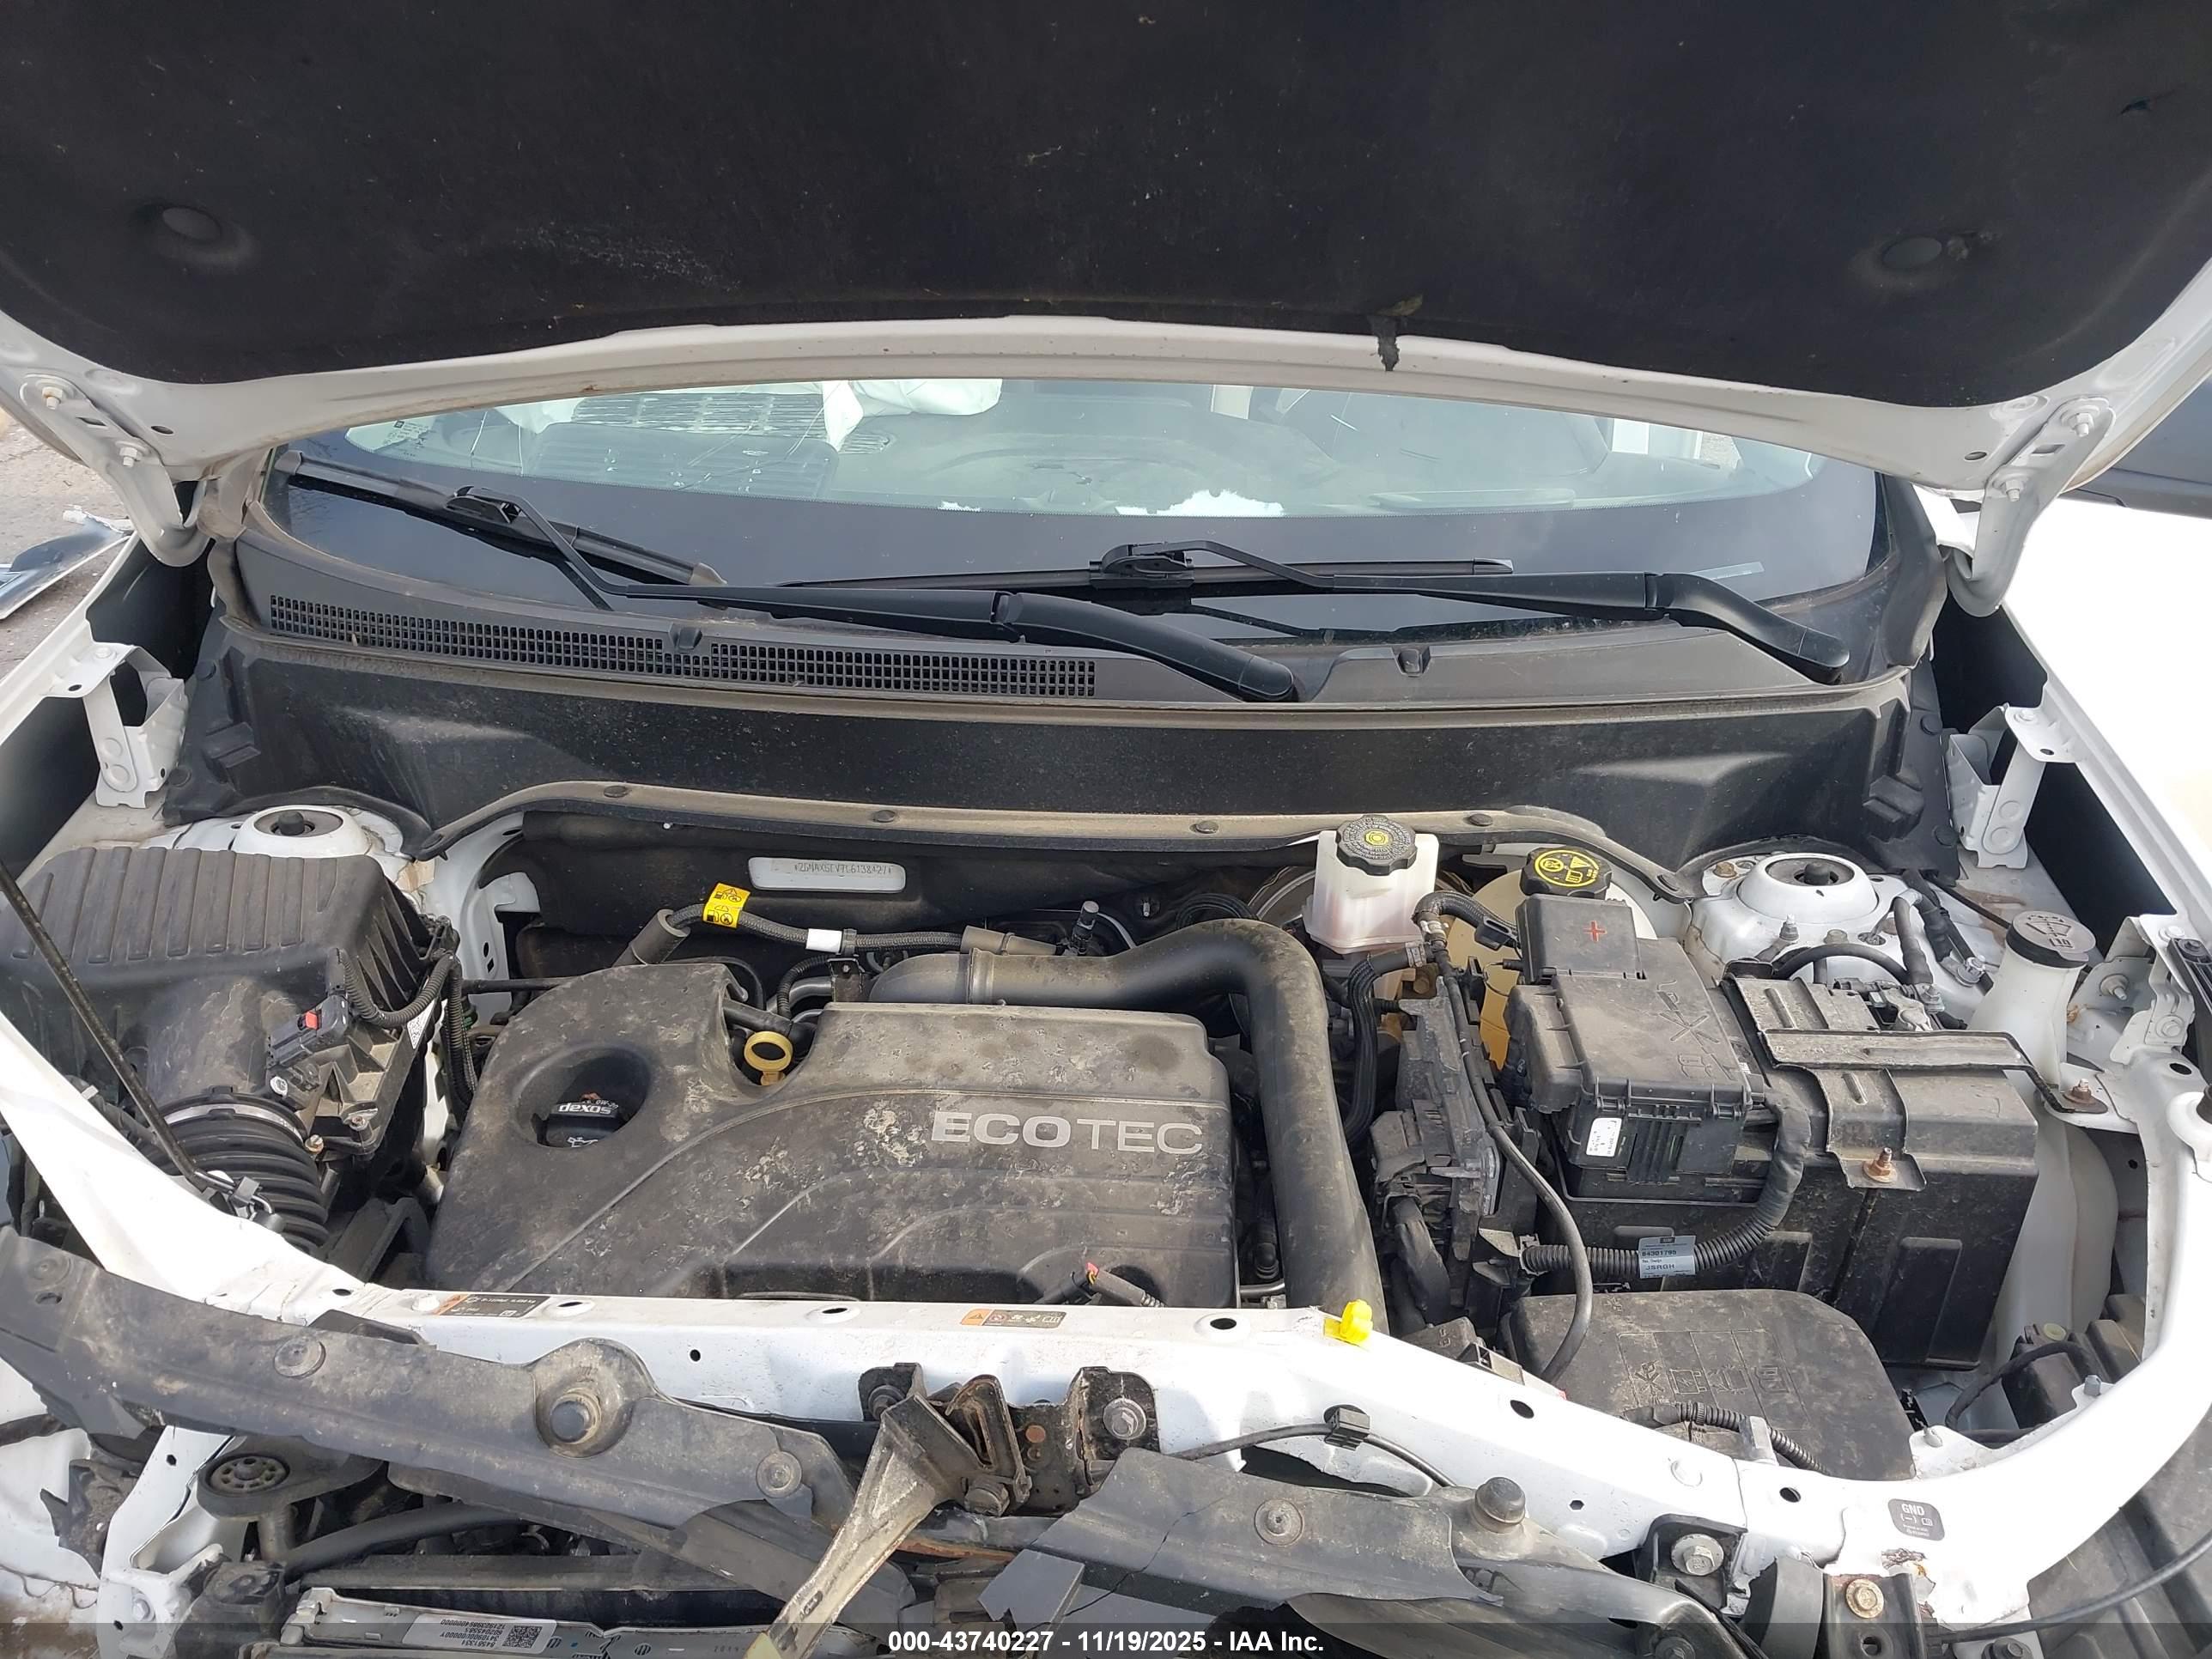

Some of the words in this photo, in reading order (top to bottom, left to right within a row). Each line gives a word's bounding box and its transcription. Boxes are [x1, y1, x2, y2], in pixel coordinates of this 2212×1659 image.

[558, 1102, 612, 1115] dexos
[931, 1111, 1204, 1155] ECOTEC
[1901, 1503, 1925, 1516] GND
